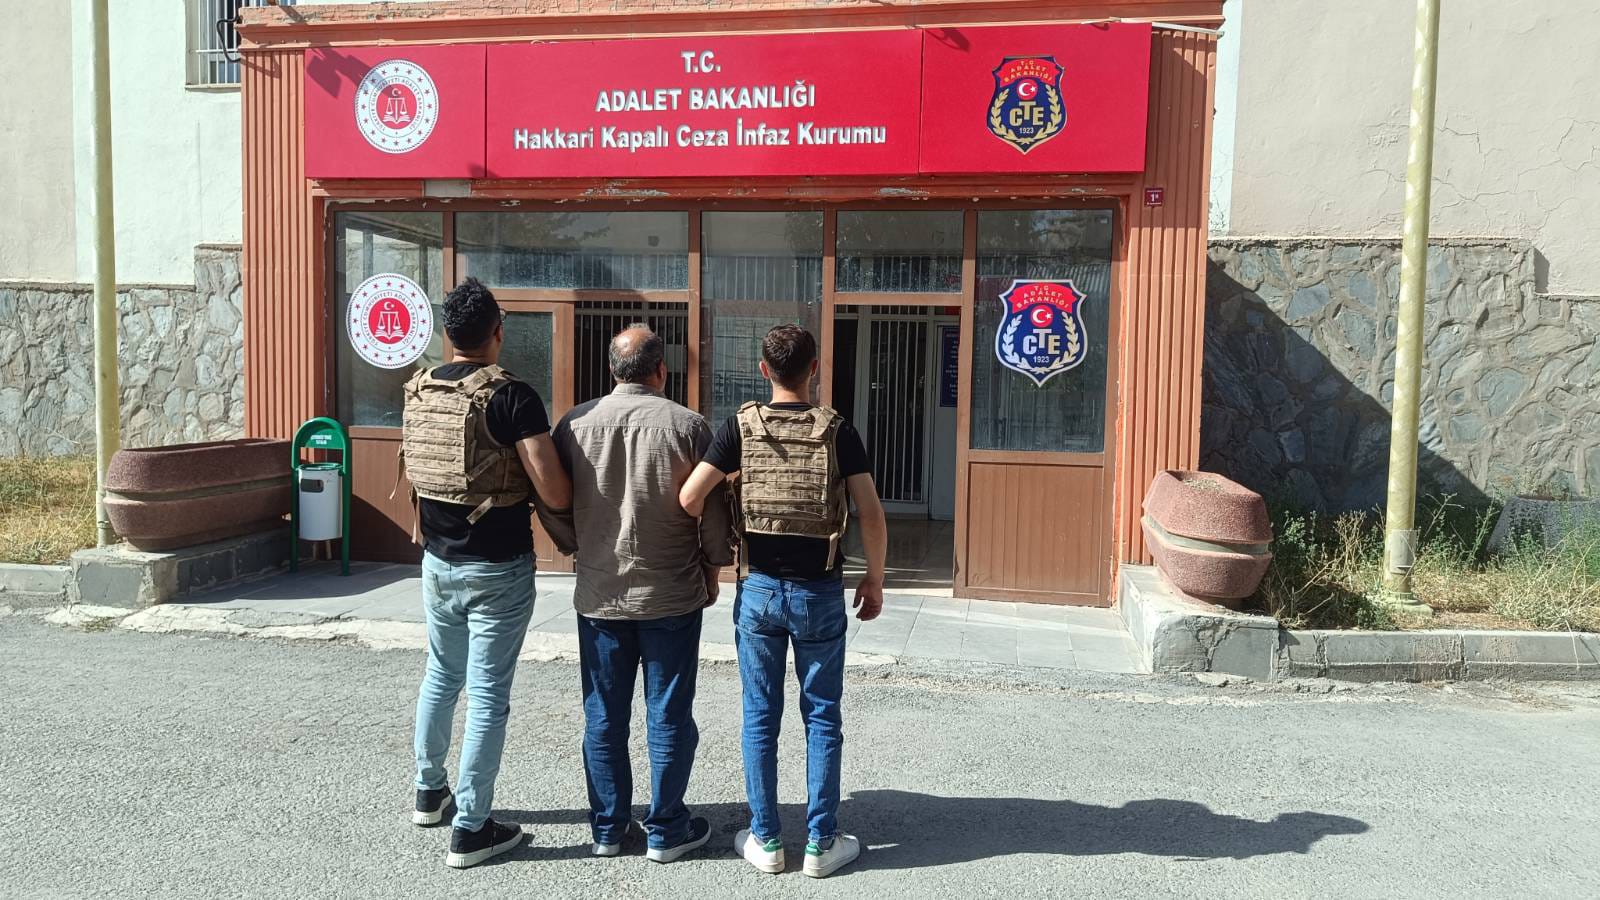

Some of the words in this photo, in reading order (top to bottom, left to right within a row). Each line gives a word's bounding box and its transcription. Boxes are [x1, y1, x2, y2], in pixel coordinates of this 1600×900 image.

[681, 51, 722, 73] T.C.
[595, 88, 681, 112] ADALET
[689, 81, 815, 110] BAKANLIĞI
[1009, 101, 1044, 126] CTE
[513, 127, 594, 150] Hakkari
[601, 125, 669, 153] Kapalı
[676, 124, 729, 147] Ceza
[737, 118, 790, 146] İnfaz
[798, 122, 887, 145] Kurumu
[1022, 329, 1061, 354] CTE
